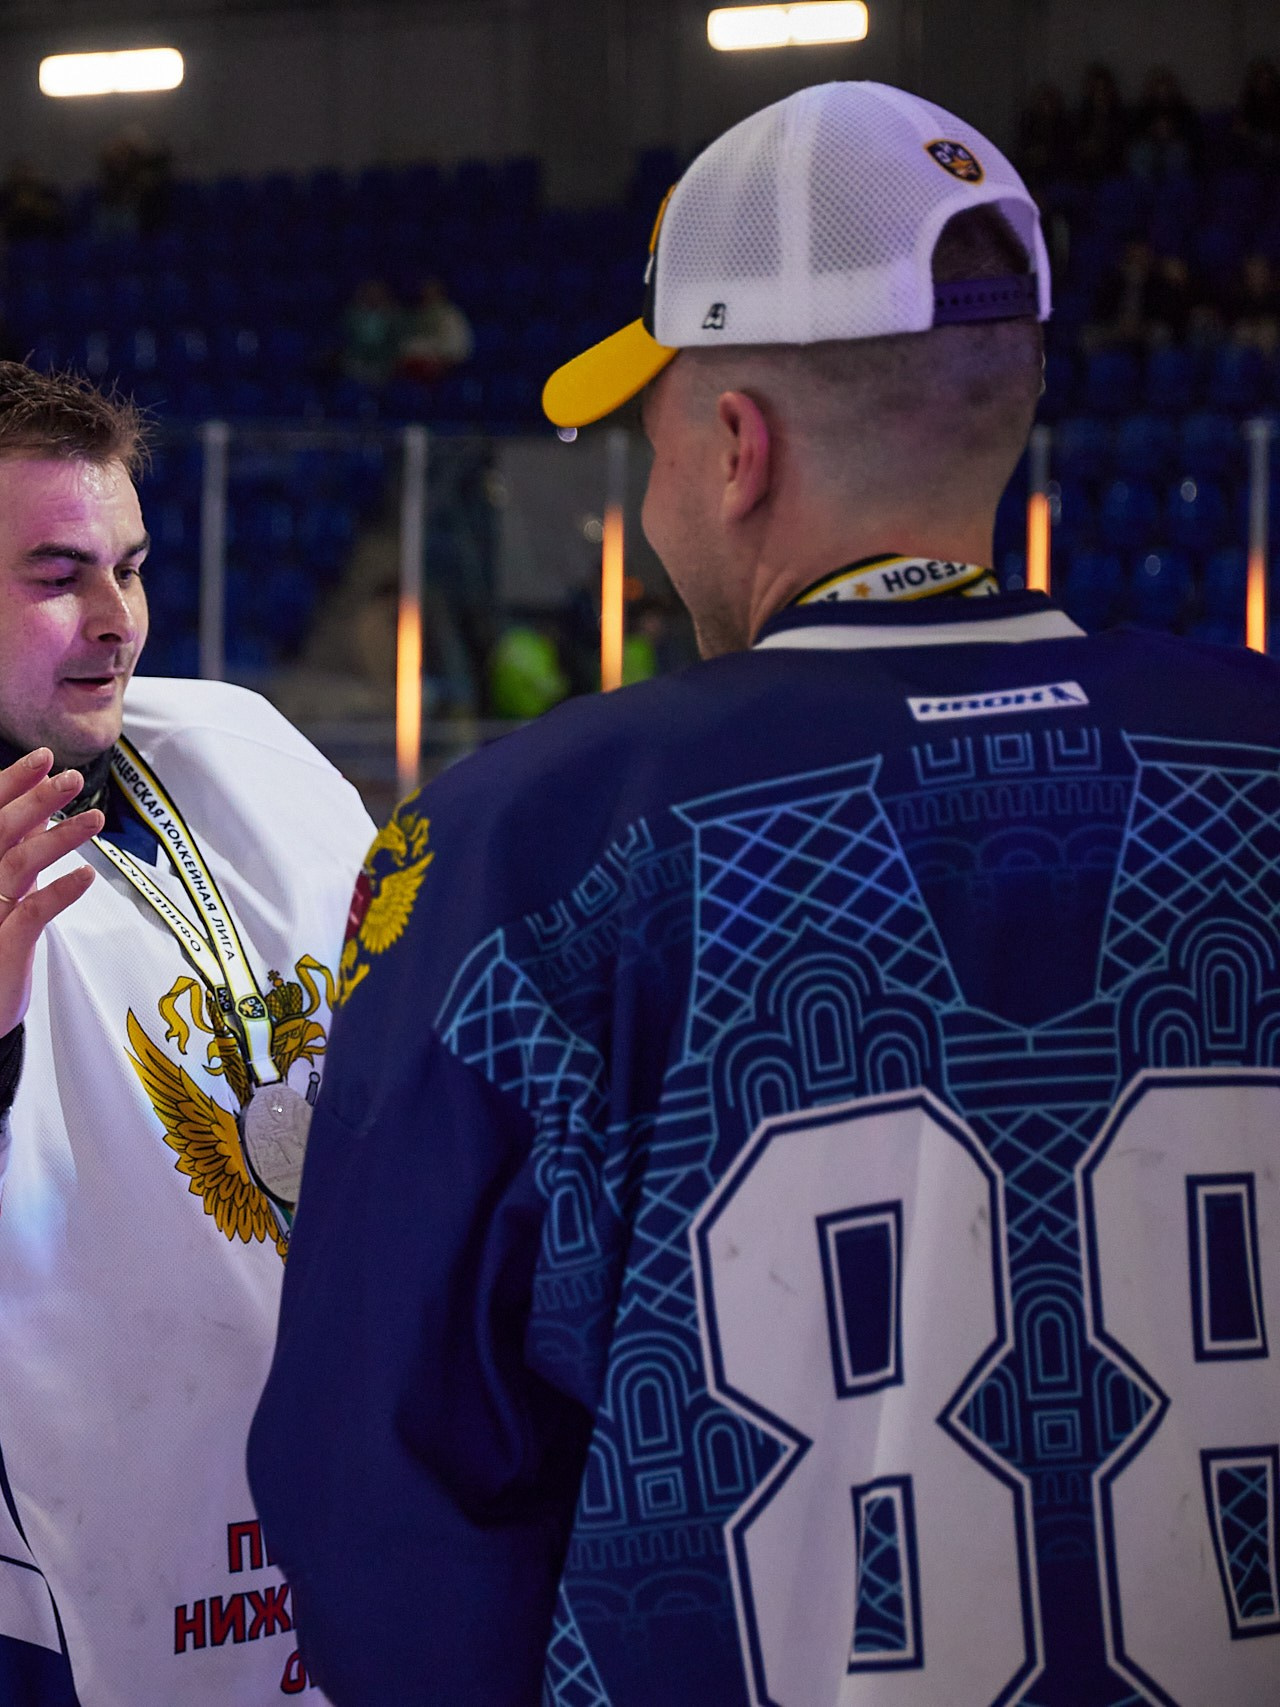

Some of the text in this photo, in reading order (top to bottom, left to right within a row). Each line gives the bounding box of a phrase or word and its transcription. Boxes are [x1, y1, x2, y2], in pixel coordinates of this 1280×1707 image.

[108, 849, 202, 953] ОФИЦЕРСКАЯ
[159, 819, 217, 912] ХОККЕЙНАЯ
[211, 917, 236, 961] ЛИГА
[689, 1067, 1280, 1707] 88
